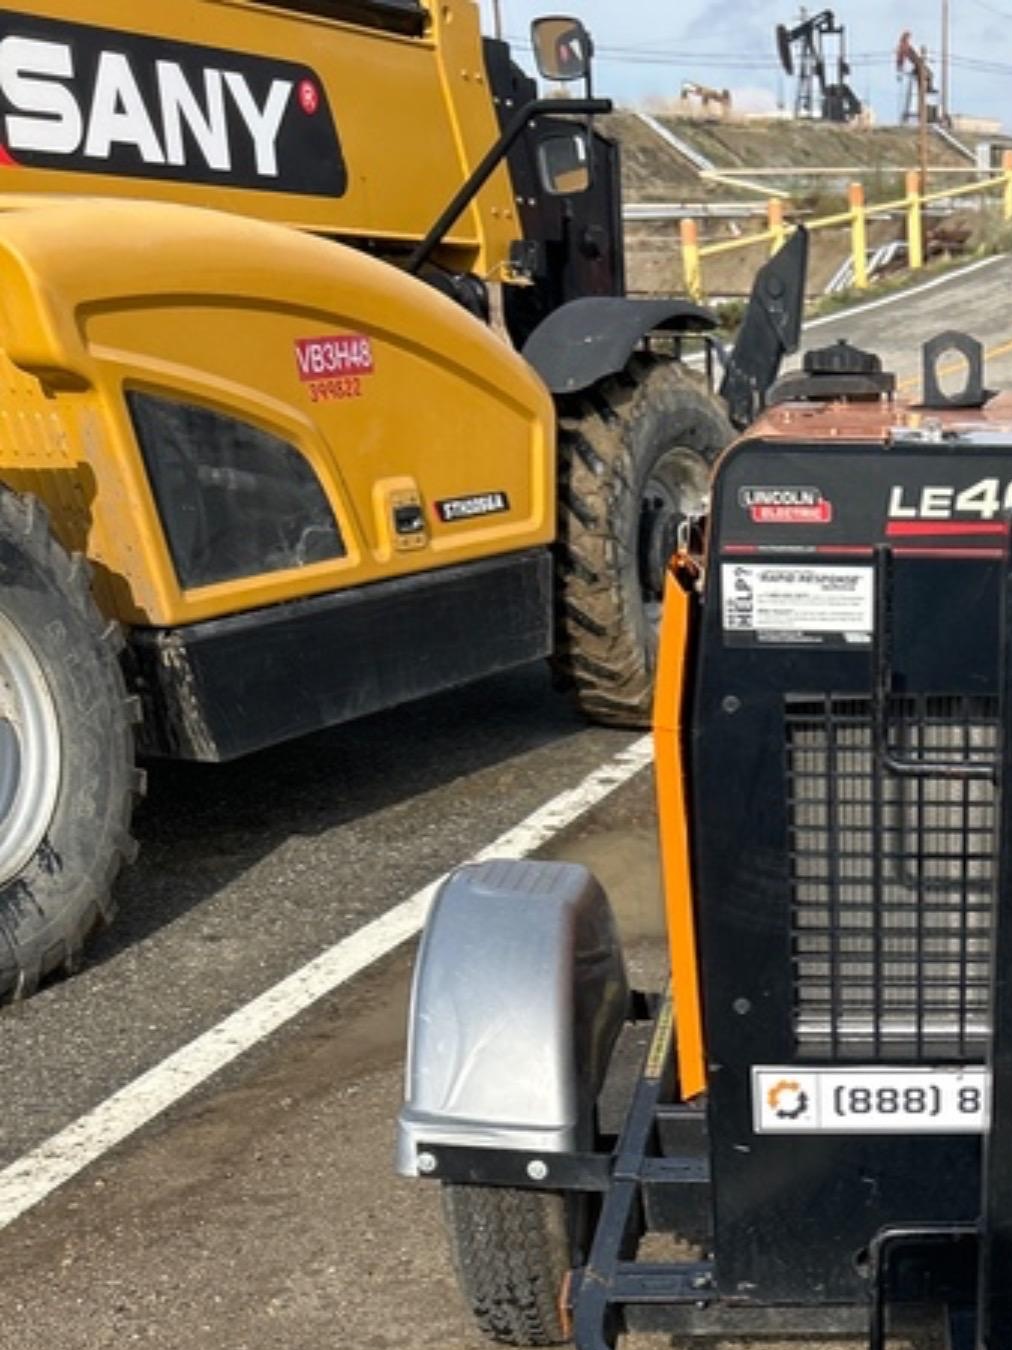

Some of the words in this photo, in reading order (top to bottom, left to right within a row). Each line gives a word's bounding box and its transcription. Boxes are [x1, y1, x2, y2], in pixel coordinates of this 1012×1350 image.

[0, 35, 294, 177] SANY
[295, 339, 372, 374] VB3H48
[743, 490, 814, 505] LINCOLN
[758, 504, 821, 521] ELECTRIC
[832, 1084, 942, 1118] (888)
